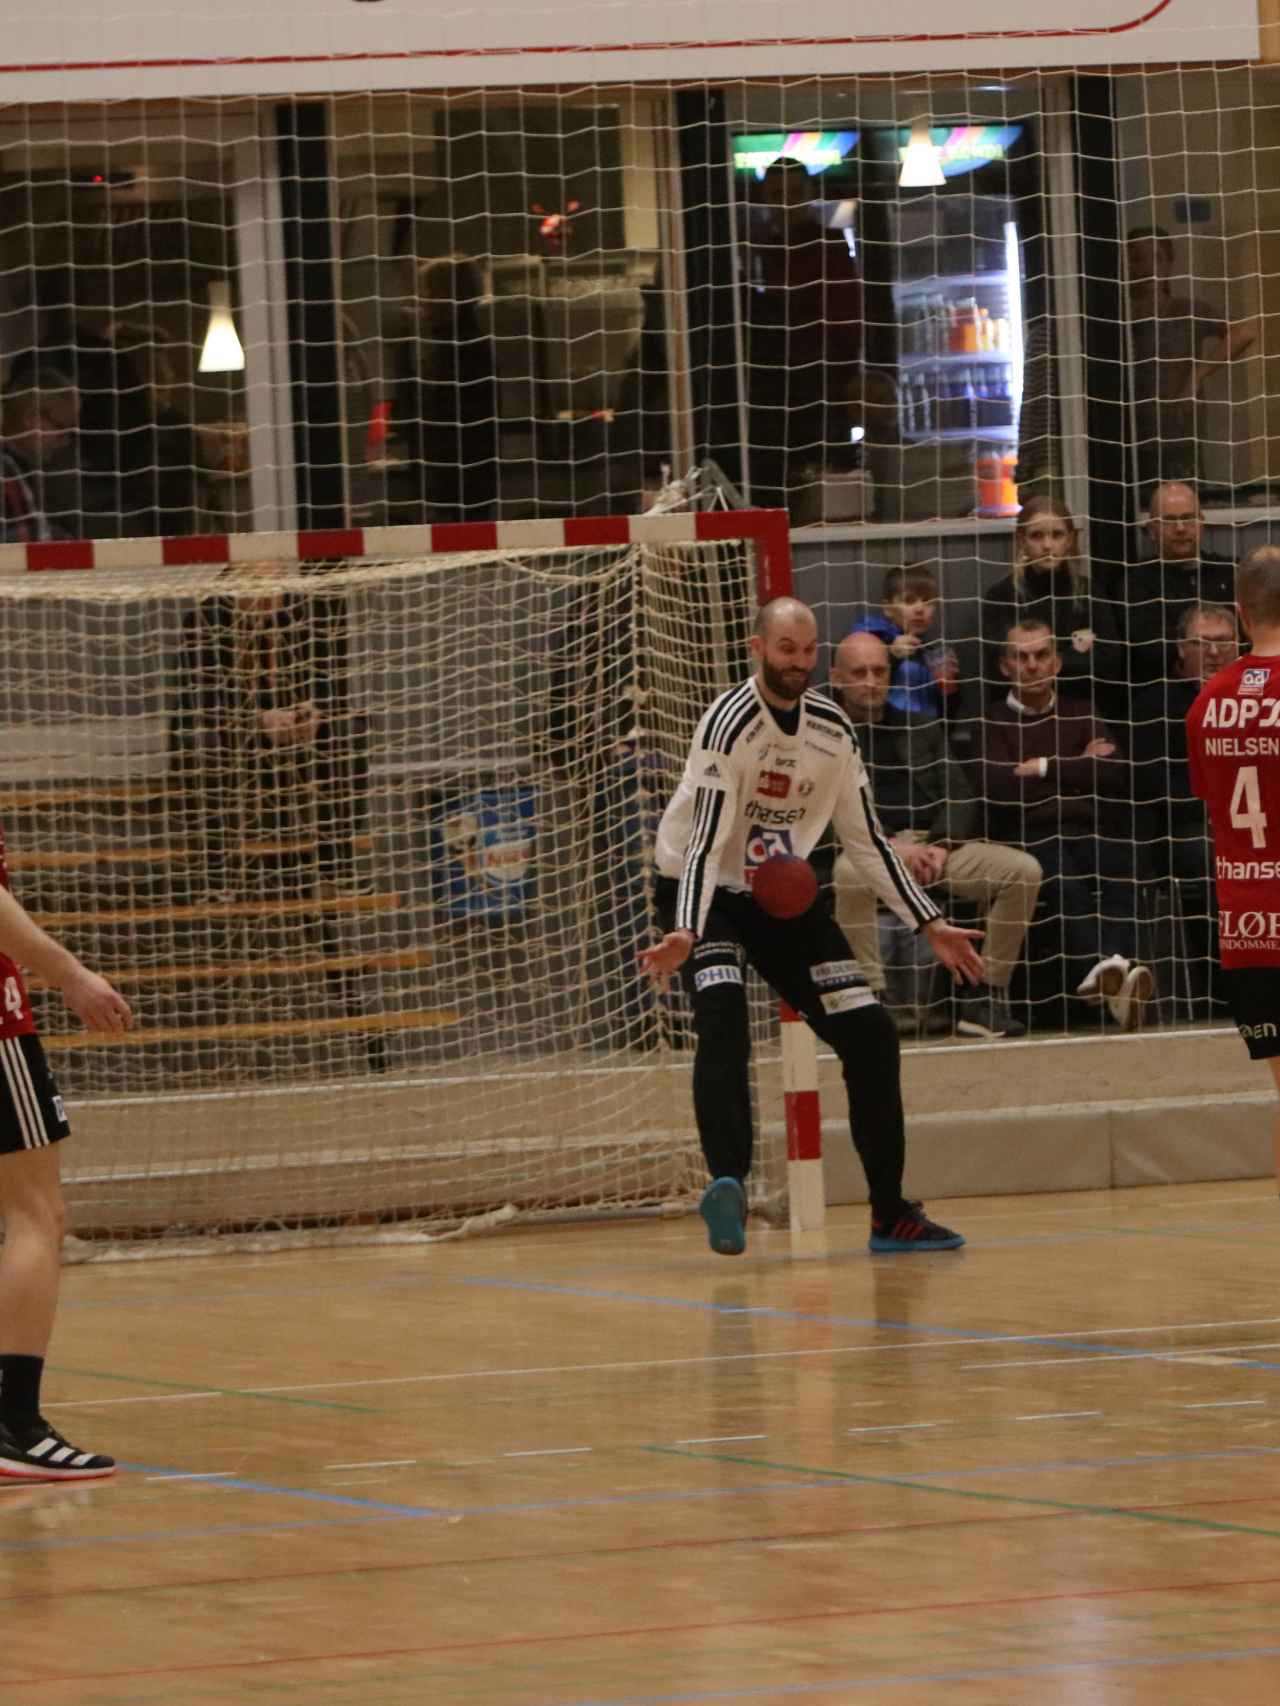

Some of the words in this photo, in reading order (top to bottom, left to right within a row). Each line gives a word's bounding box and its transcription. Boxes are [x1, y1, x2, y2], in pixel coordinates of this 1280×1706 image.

[1205, 738, 1280, 756] NIELSEN
[1229, 766, 1267, 849] 4
[0, 976, 24, 1024] 4
